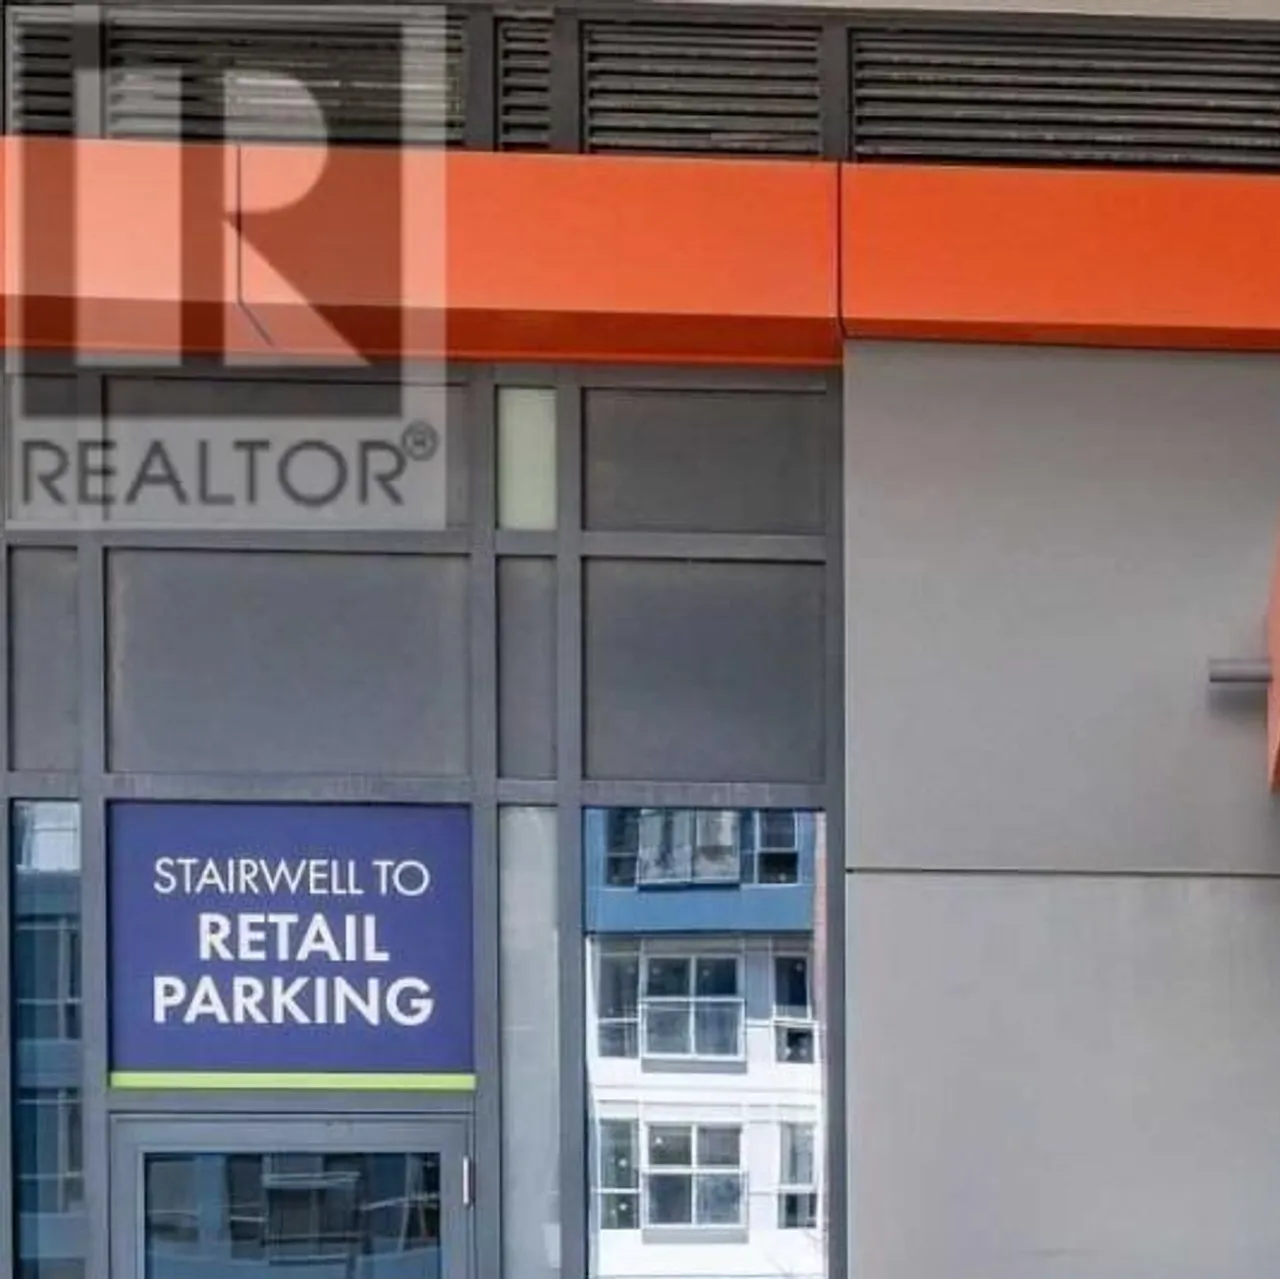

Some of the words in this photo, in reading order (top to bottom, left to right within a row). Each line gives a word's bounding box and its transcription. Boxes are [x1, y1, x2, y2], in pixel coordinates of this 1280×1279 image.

[153, 857, 364, 895] STAIRWELL
[372, 859, 431, 897] TO
[198, 912, 391, 962] RETAIL
[152, 975, 436, 1026] PARKING
